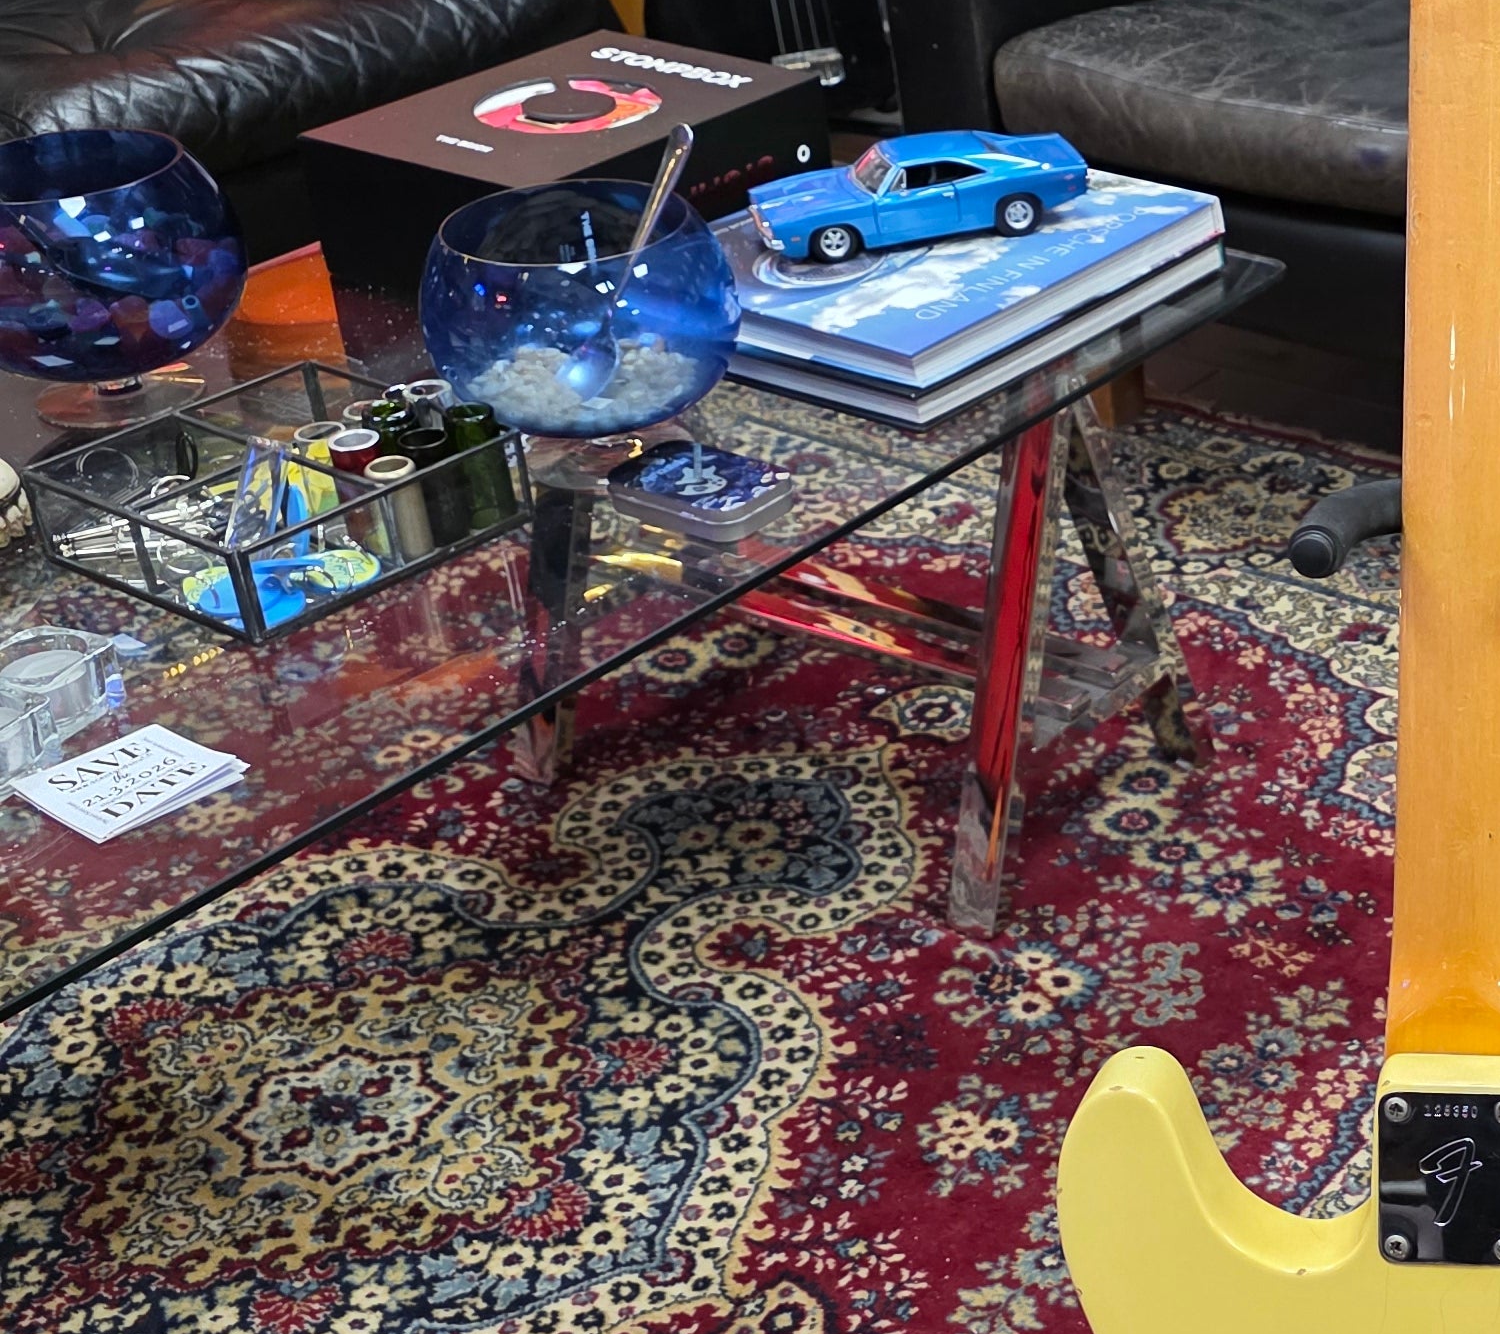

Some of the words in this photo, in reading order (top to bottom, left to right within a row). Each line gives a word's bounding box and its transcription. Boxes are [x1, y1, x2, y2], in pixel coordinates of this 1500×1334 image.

[1044, 206, 1149, 257] PORSCHE
[1017, 255, 1051, 271] IN
[915, 267, 1023, 320] FINLAND
[48, 742, 151, 792] SAVE
[102, 762, 207, 818] DATE
